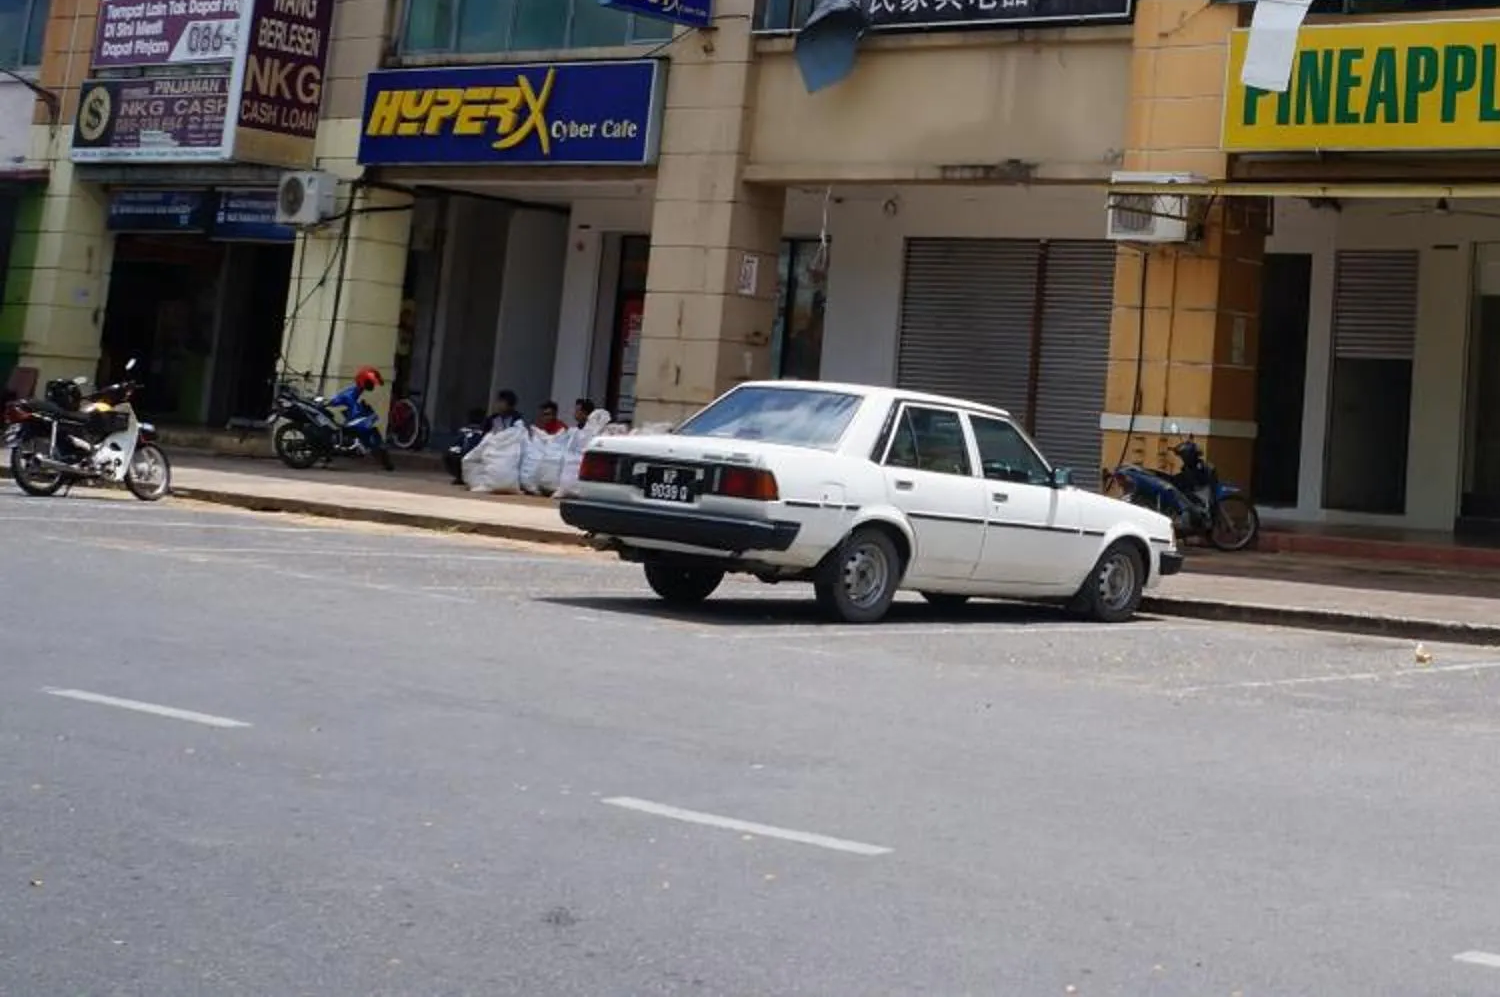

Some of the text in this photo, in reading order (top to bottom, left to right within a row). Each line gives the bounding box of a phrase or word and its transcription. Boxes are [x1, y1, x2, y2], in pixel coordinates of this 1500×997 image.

[257, 16, 321, 58] BERLESEN
[153, 78, 219, 94] PINJAMAN
[244, 54, 321, 105] NKG
[119, 100, 164, 116] NKG
[241, 99, 318, 131] CASH LOAN
[366, 68, 556, 155] HYPERX
[551, 118, 638, 142] Cyber Cafe
